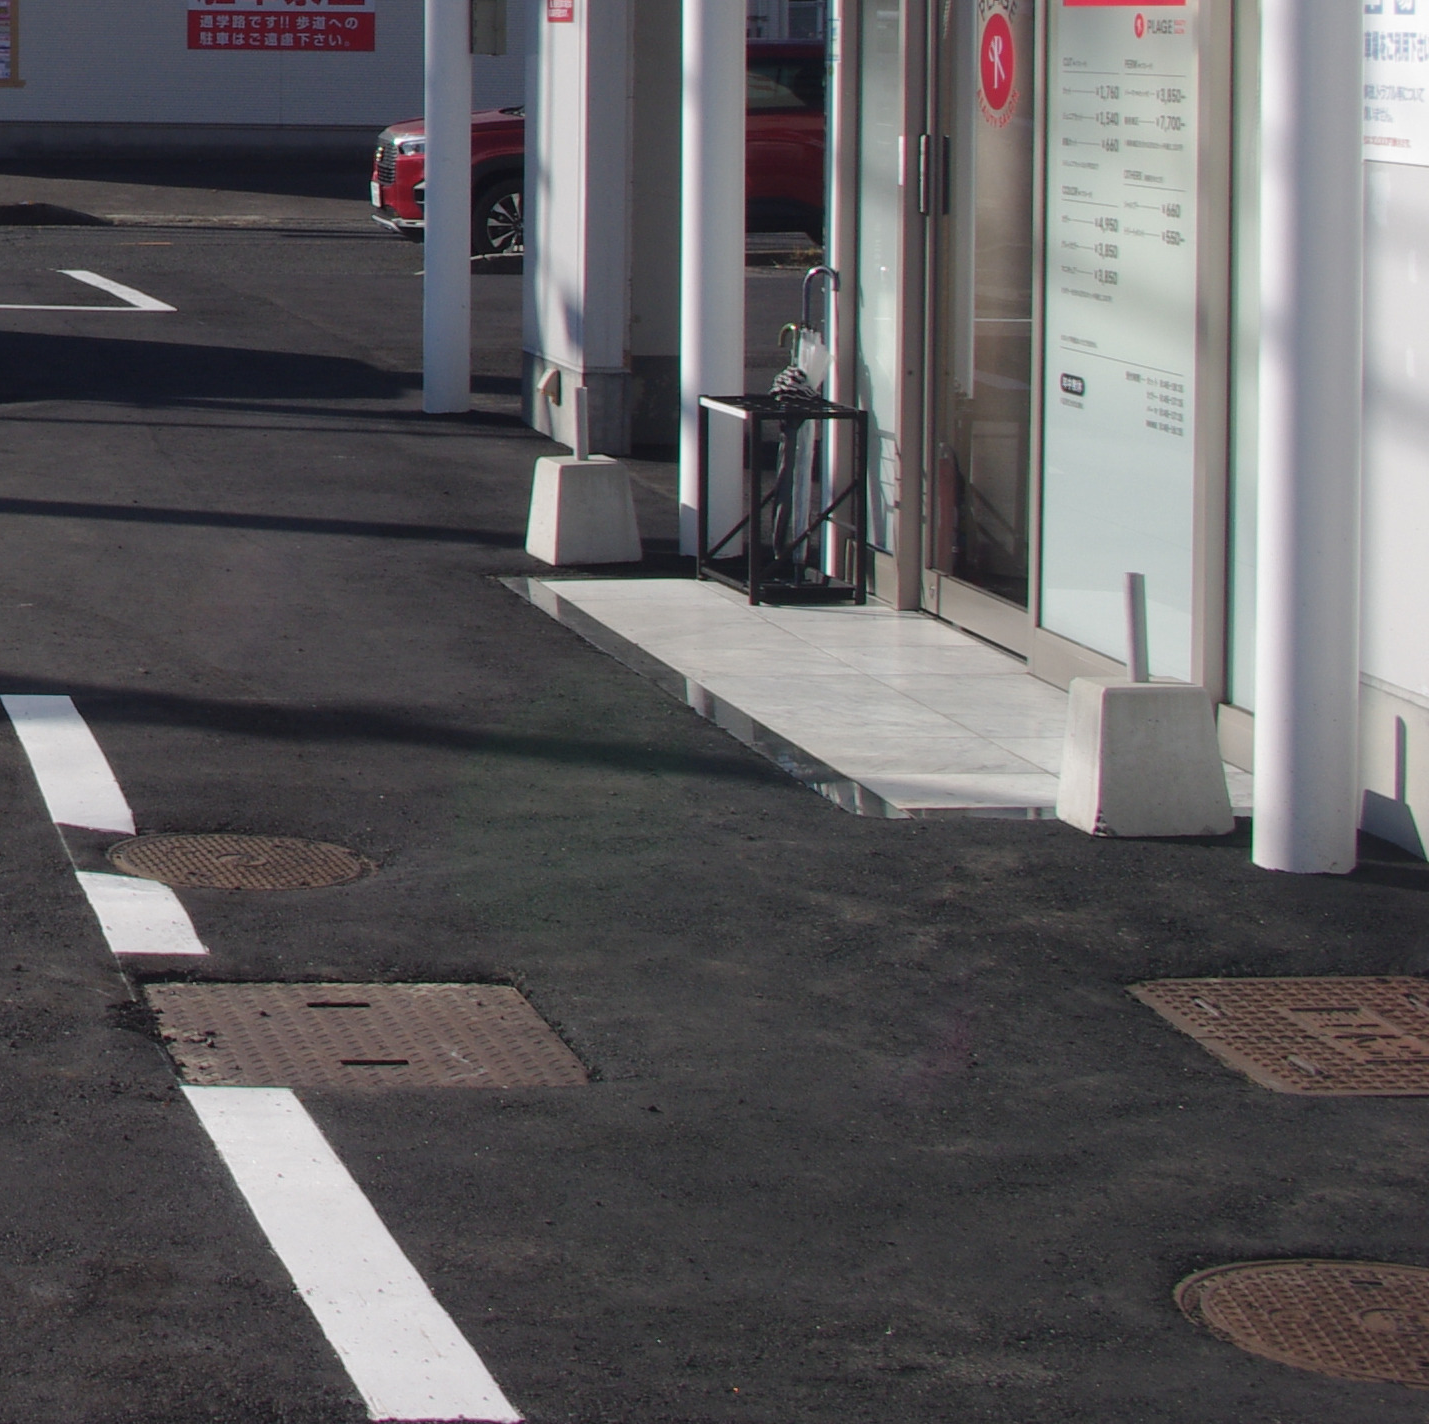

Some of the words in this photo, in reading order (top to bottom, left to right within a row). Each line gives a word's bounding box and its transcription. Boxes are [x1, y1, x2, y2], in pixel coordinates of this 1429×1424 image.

[199, 14, 290, 30] 通学路です!!
[295, 16, 359, 31] 歩道への
[1146, 19, 1173, 35] PLAGE
[199, 31, 351, 48] 駐車はご遠慮下さい。
